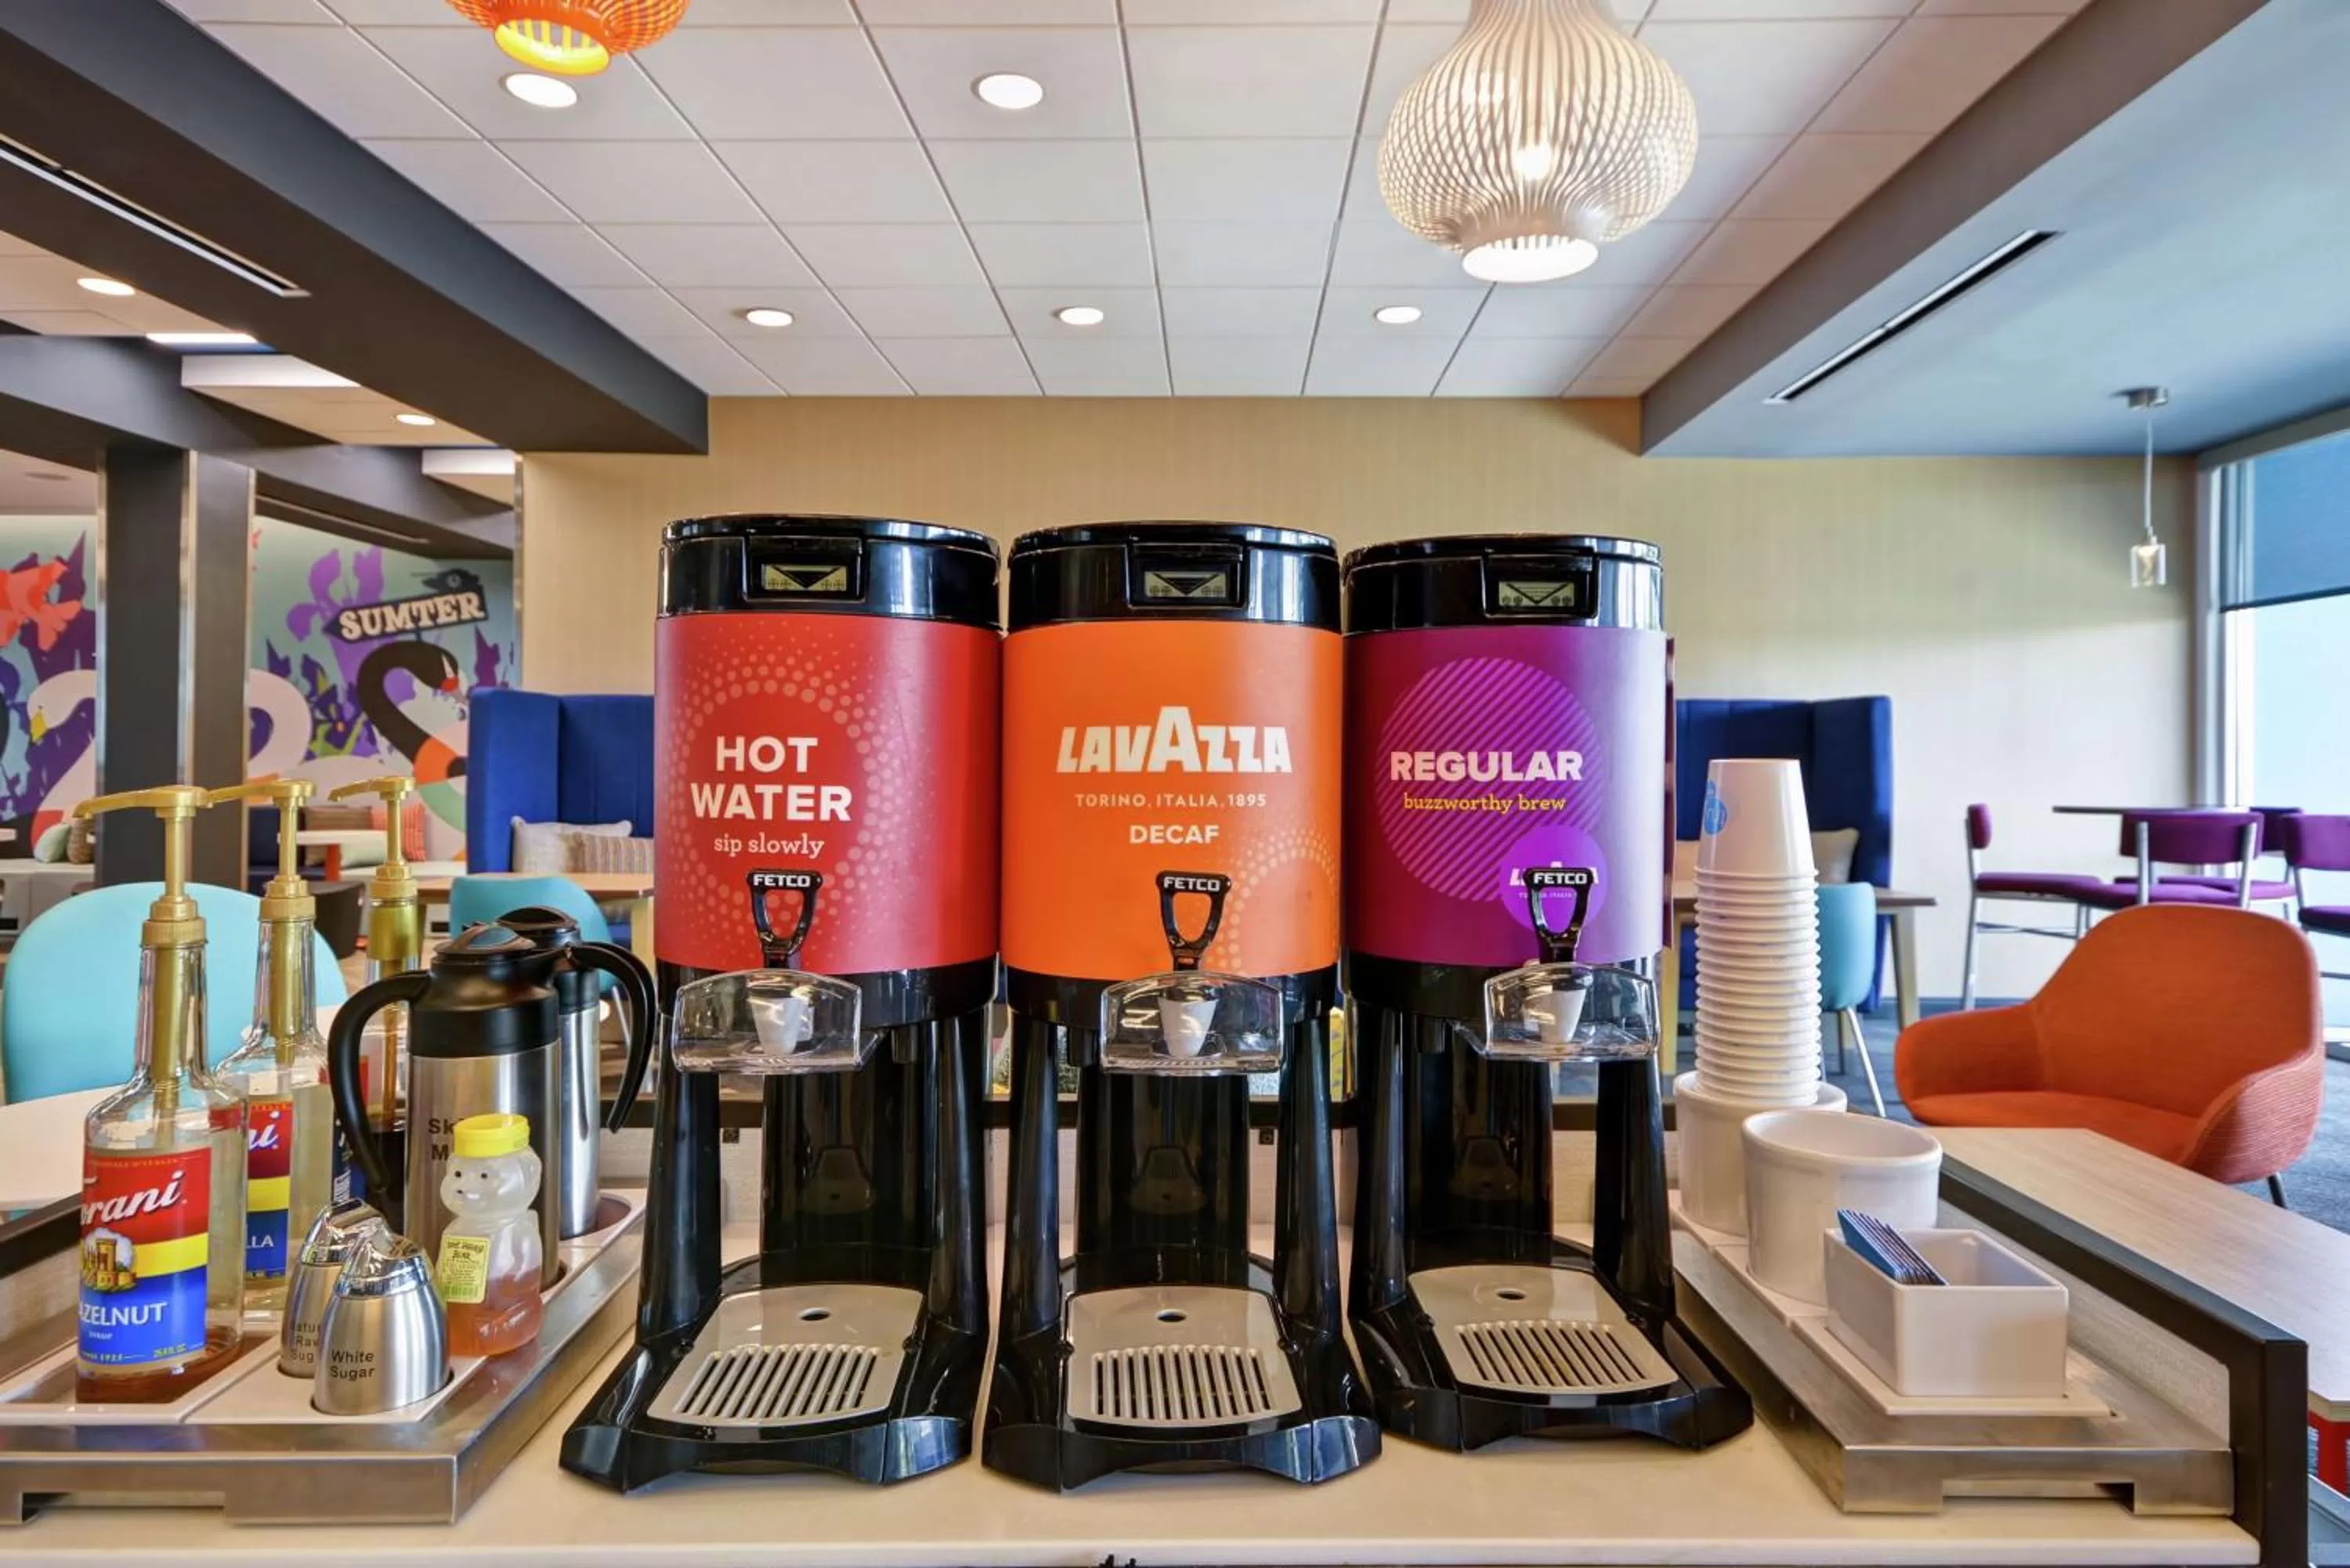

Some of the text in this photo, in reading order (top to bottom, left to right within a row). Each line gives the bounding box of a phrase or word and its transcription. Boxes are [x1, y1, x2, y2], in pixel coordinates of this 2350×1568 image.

[338, 591, 486, 641] SUMTER
[1056, 706, 1292, 773] LAVAZZA
[716, 736, 819, 773] HOT
[1390, 751, 1583, 782] REGULAR
[691, 783, 853, 822] WATER
[1227, 793, 1267, 807] 1895
[1403, 792, 1566, 815] buzzworthy brew
[1130, 825, 1220, 844] DECAF
[714, 832, 825, 859] sip slowly
[753, 873, 811, 887] FETCO
[1163, 876, 1220, 891] FETCO
[1533, 872, 1587, 885] FETCO
[331, 1348, 374, 1364] White
[330, 1365, 376, 1382] Sugar
